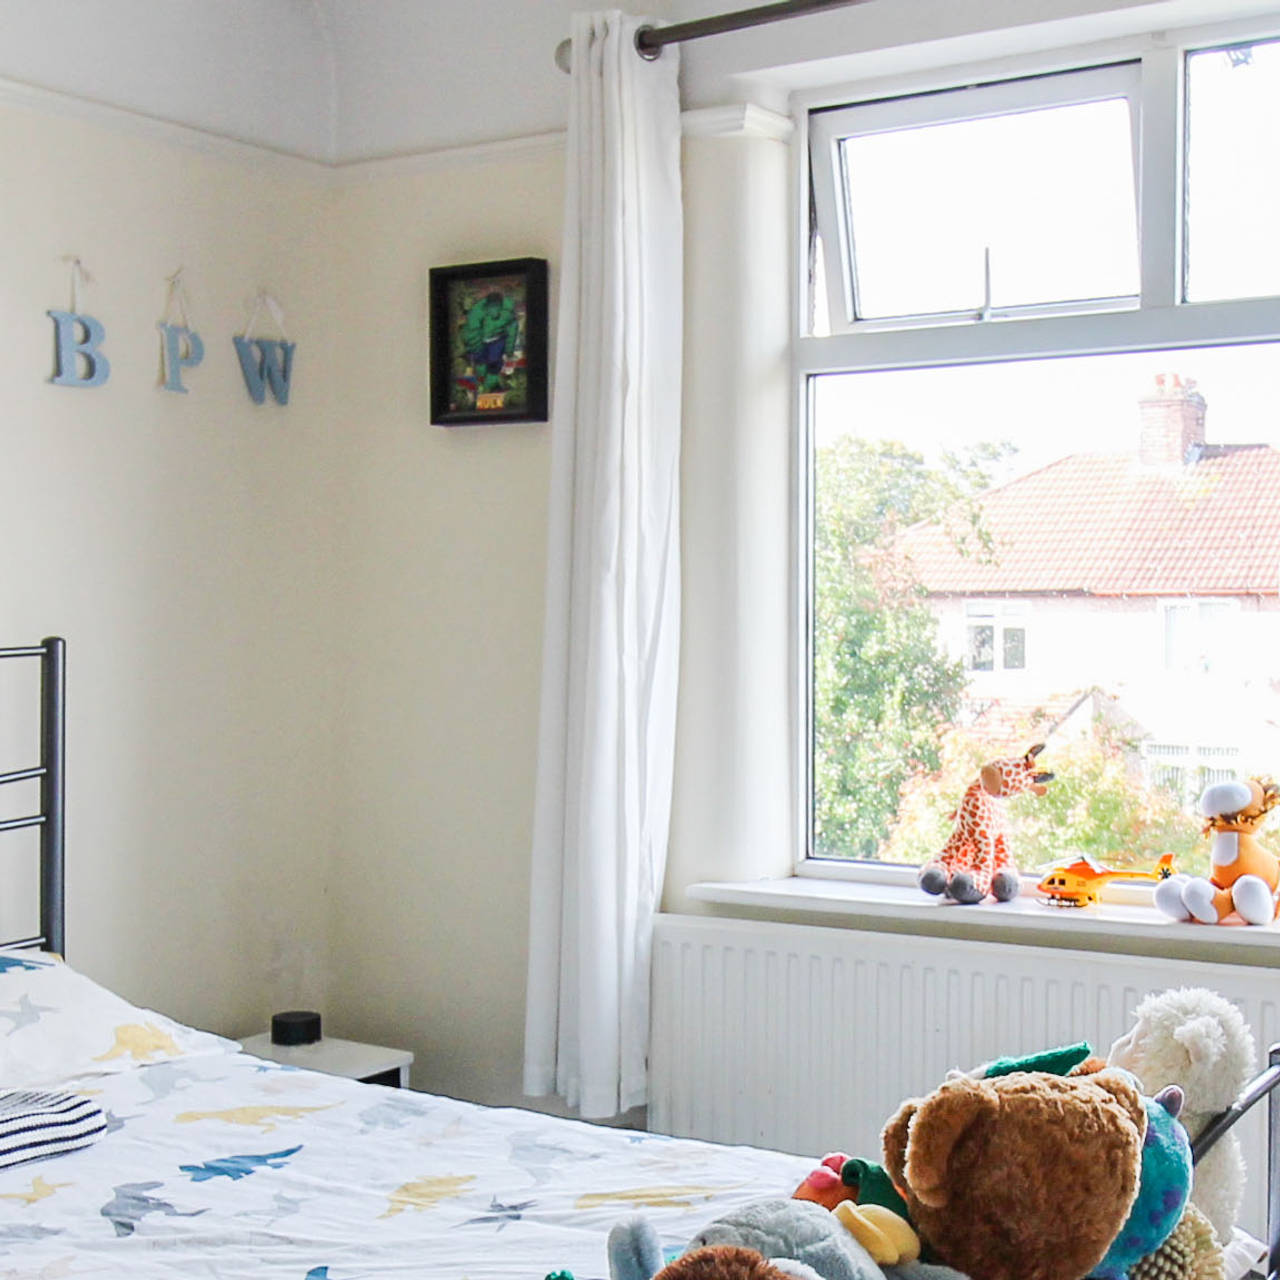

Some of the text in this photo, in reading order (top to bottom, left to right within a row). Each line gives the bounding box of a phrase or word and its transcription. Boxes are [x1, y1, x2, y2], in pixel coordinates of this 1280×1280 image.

[46, 308, 297, 406] B P W
